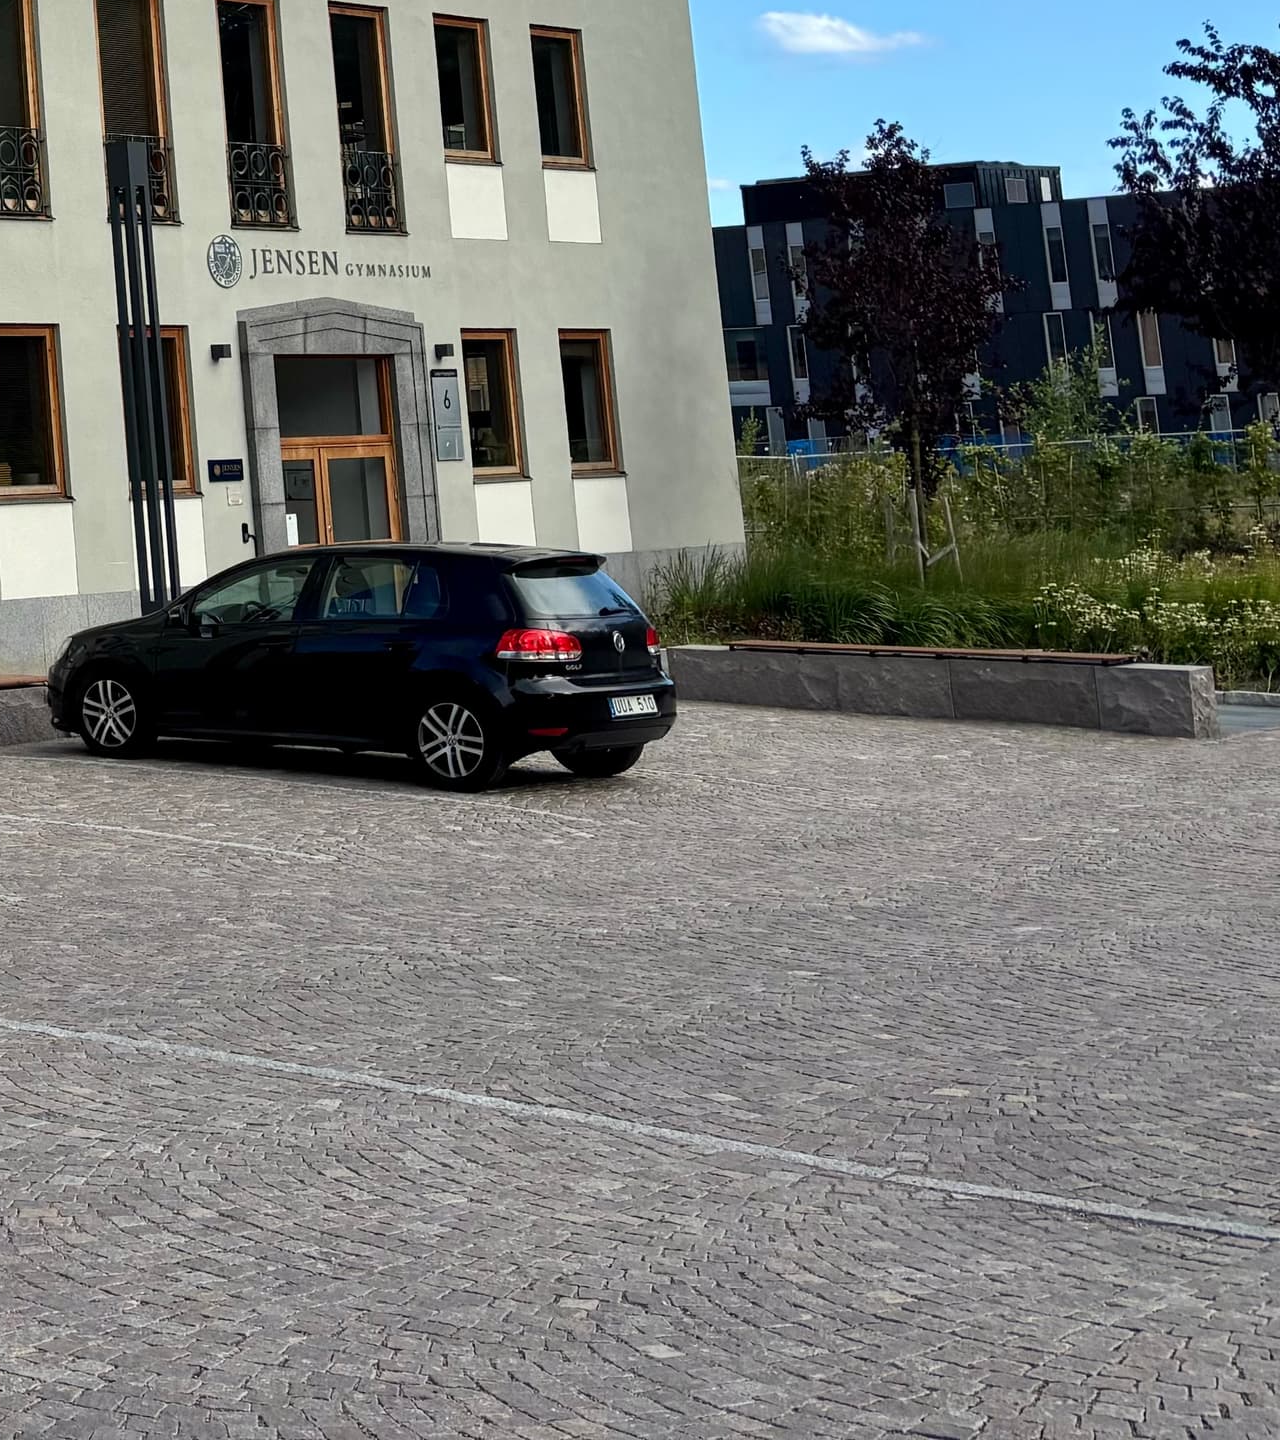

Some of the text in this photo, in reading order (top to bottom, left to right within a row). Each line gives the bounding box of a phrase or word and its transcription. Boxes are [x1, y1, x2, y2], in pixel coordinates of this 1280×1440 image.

[249, 248, 340, 280] JENSEN
[345, 263, 432, 279] GYMNASIUM
[443, 388, 451, 410] 6
[636, 695, 656, 711] 510
